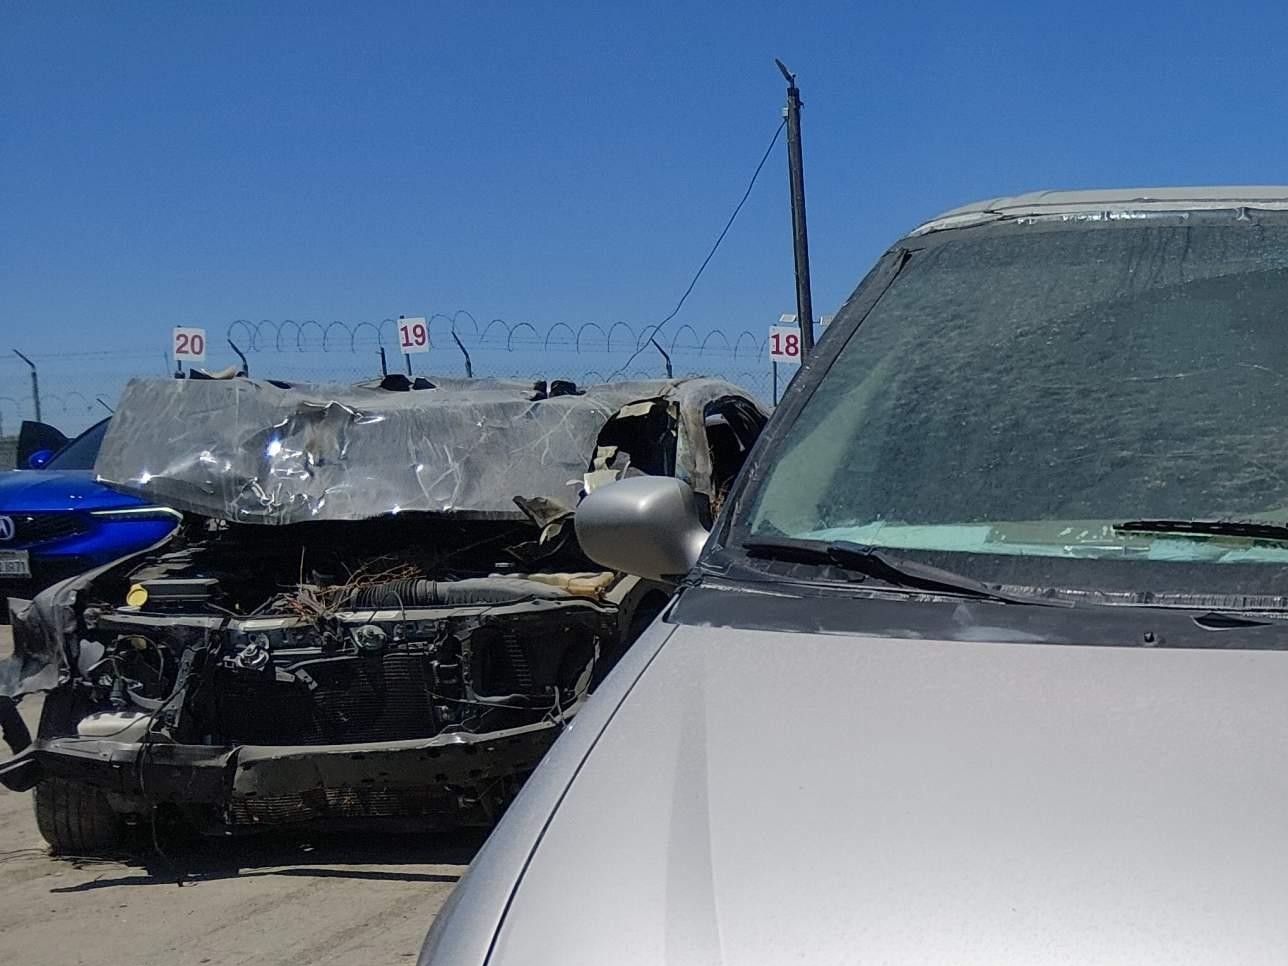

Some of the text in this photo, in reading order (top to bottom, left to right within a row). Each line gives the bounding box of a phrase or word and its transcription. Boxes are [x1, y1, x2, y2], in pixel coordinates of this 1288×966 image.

[176, 333, 204, 355] 20
[400, 324, 426, 347] 19
[771, 333, 799, 357] 18
